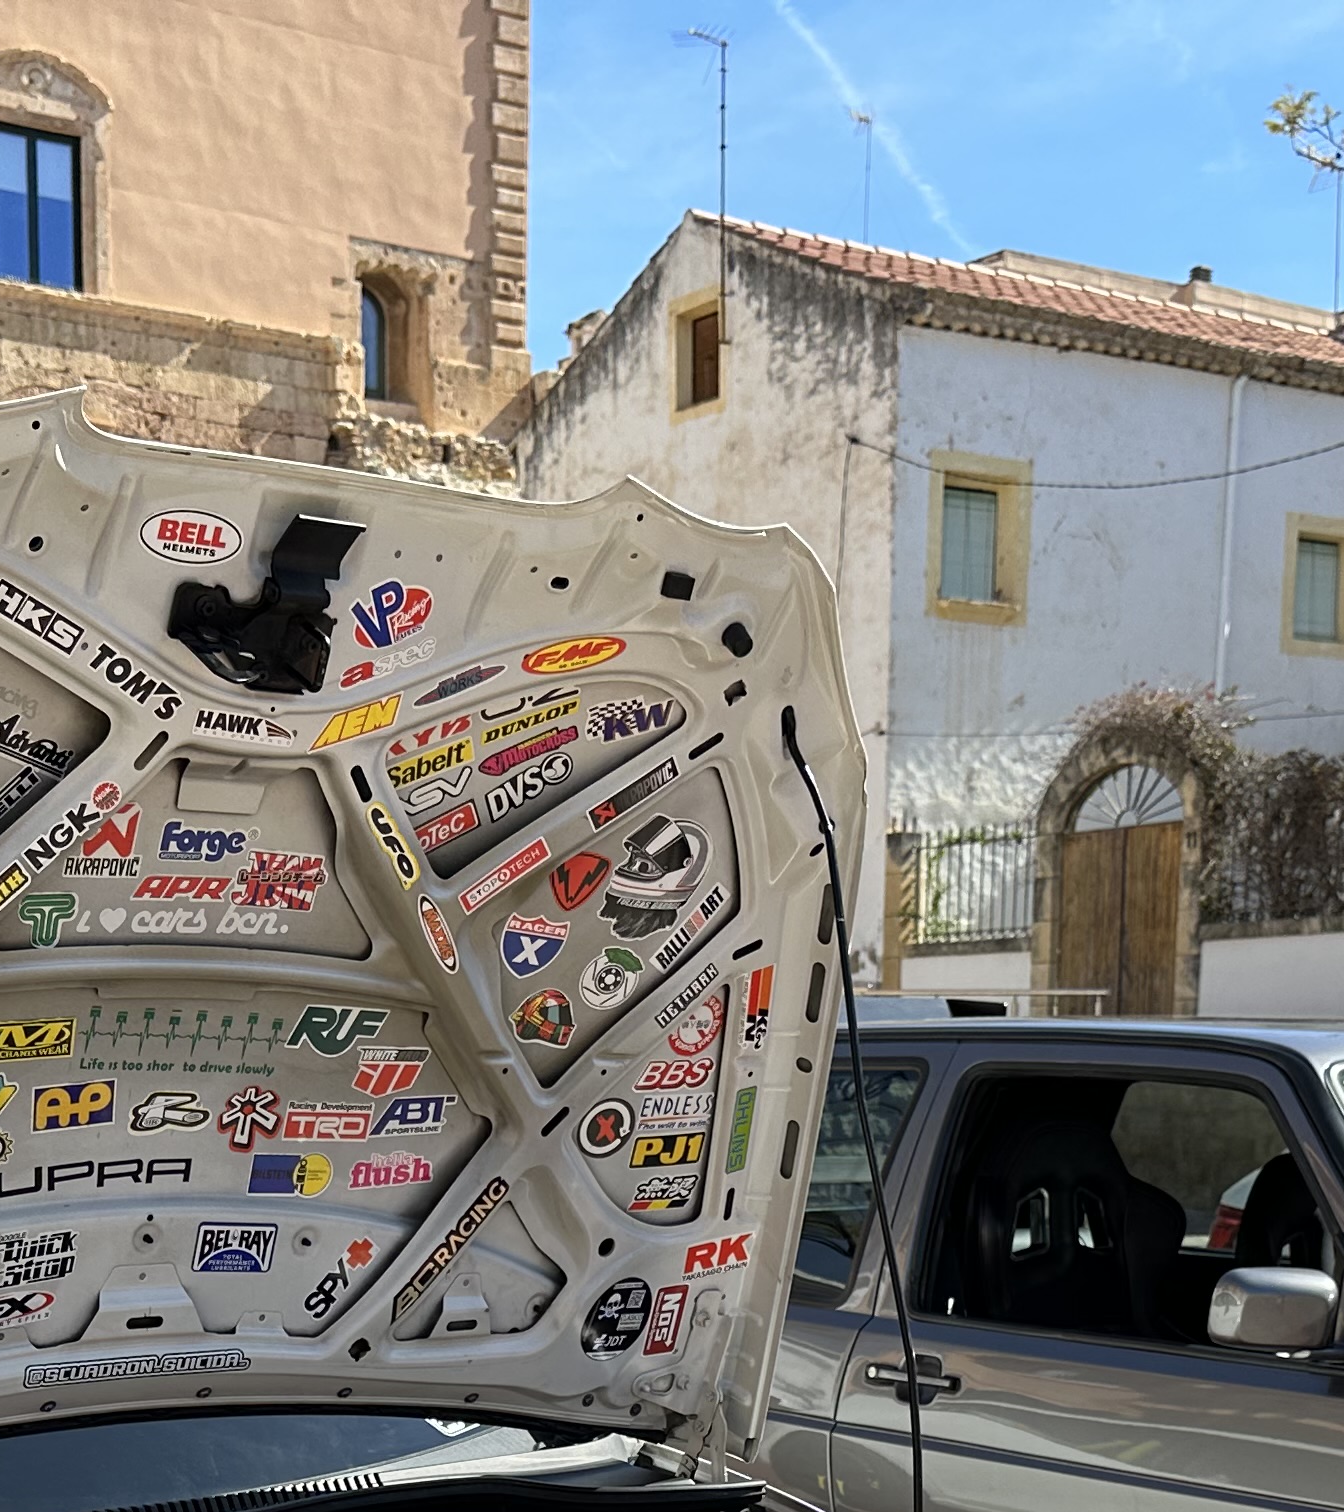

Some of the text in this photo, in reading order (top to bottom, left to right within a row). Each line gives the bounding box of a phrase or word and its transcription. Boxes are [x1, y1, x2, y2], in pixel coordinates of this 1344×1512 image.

[157, 519, 226, 548] BELL
[162, 542, 216, 557] HELMETS
[352, 581, 405, 648] VP
[527, 642, 616, 668] FMF
[89, 644, 182, 720] TOM'S
[437, 673, 483, 698] WORKS
[195, 710, 264, 735] HAWK
[310, 695, 402, 750] AEM
[485, 702, 577, 742] DUNLOP
[603, 700, 676, 742] KW
[390, 741, 468, 787] Sabelt
[487, 765, 542, 822] DVS
[24, 803, 100, 870] NGK
[160, 822, 246, 862] Forge
[371, 808, 413, 878] UFO
[133, 877, 231, 899] APR
[131, 907, 207, 933] cars
[509, 919, 567, 937] RACER
[512, 935, 548, 967] X
[286, 1006, 390, 1056] RUF
[39, 1043, 69, 1056] WEAR
[361, 1050, 398, 1061] WHITE
[80, 1058, 104, 1070] Life
[109, 1060, 117, 1070] is
[123, 1060, 143, 1071] too
[183, 1061, 196, 1072] to
[200, 1061, 232, 1073] drive
[236, 1061, 274, 1077] slowly
[636, 1058, 714, 1090] BBS
[288, 1102, 373, 1113] Racing Development
[371, 1096, 457, 1135] ABT
[640, 1094, 715, 1117] ENDLESS
[291, 1116, 366, 1139] TRD
[385, 1126, 440, 1135] SPORTSLINE
[632, 1134, 704, 1166] PJ1
[349, 1158, 431, 1189] flush
[684, 1233, 754, 1274] RK
[682, 1261, 748, 1281] TAKASAGO CHAIN
